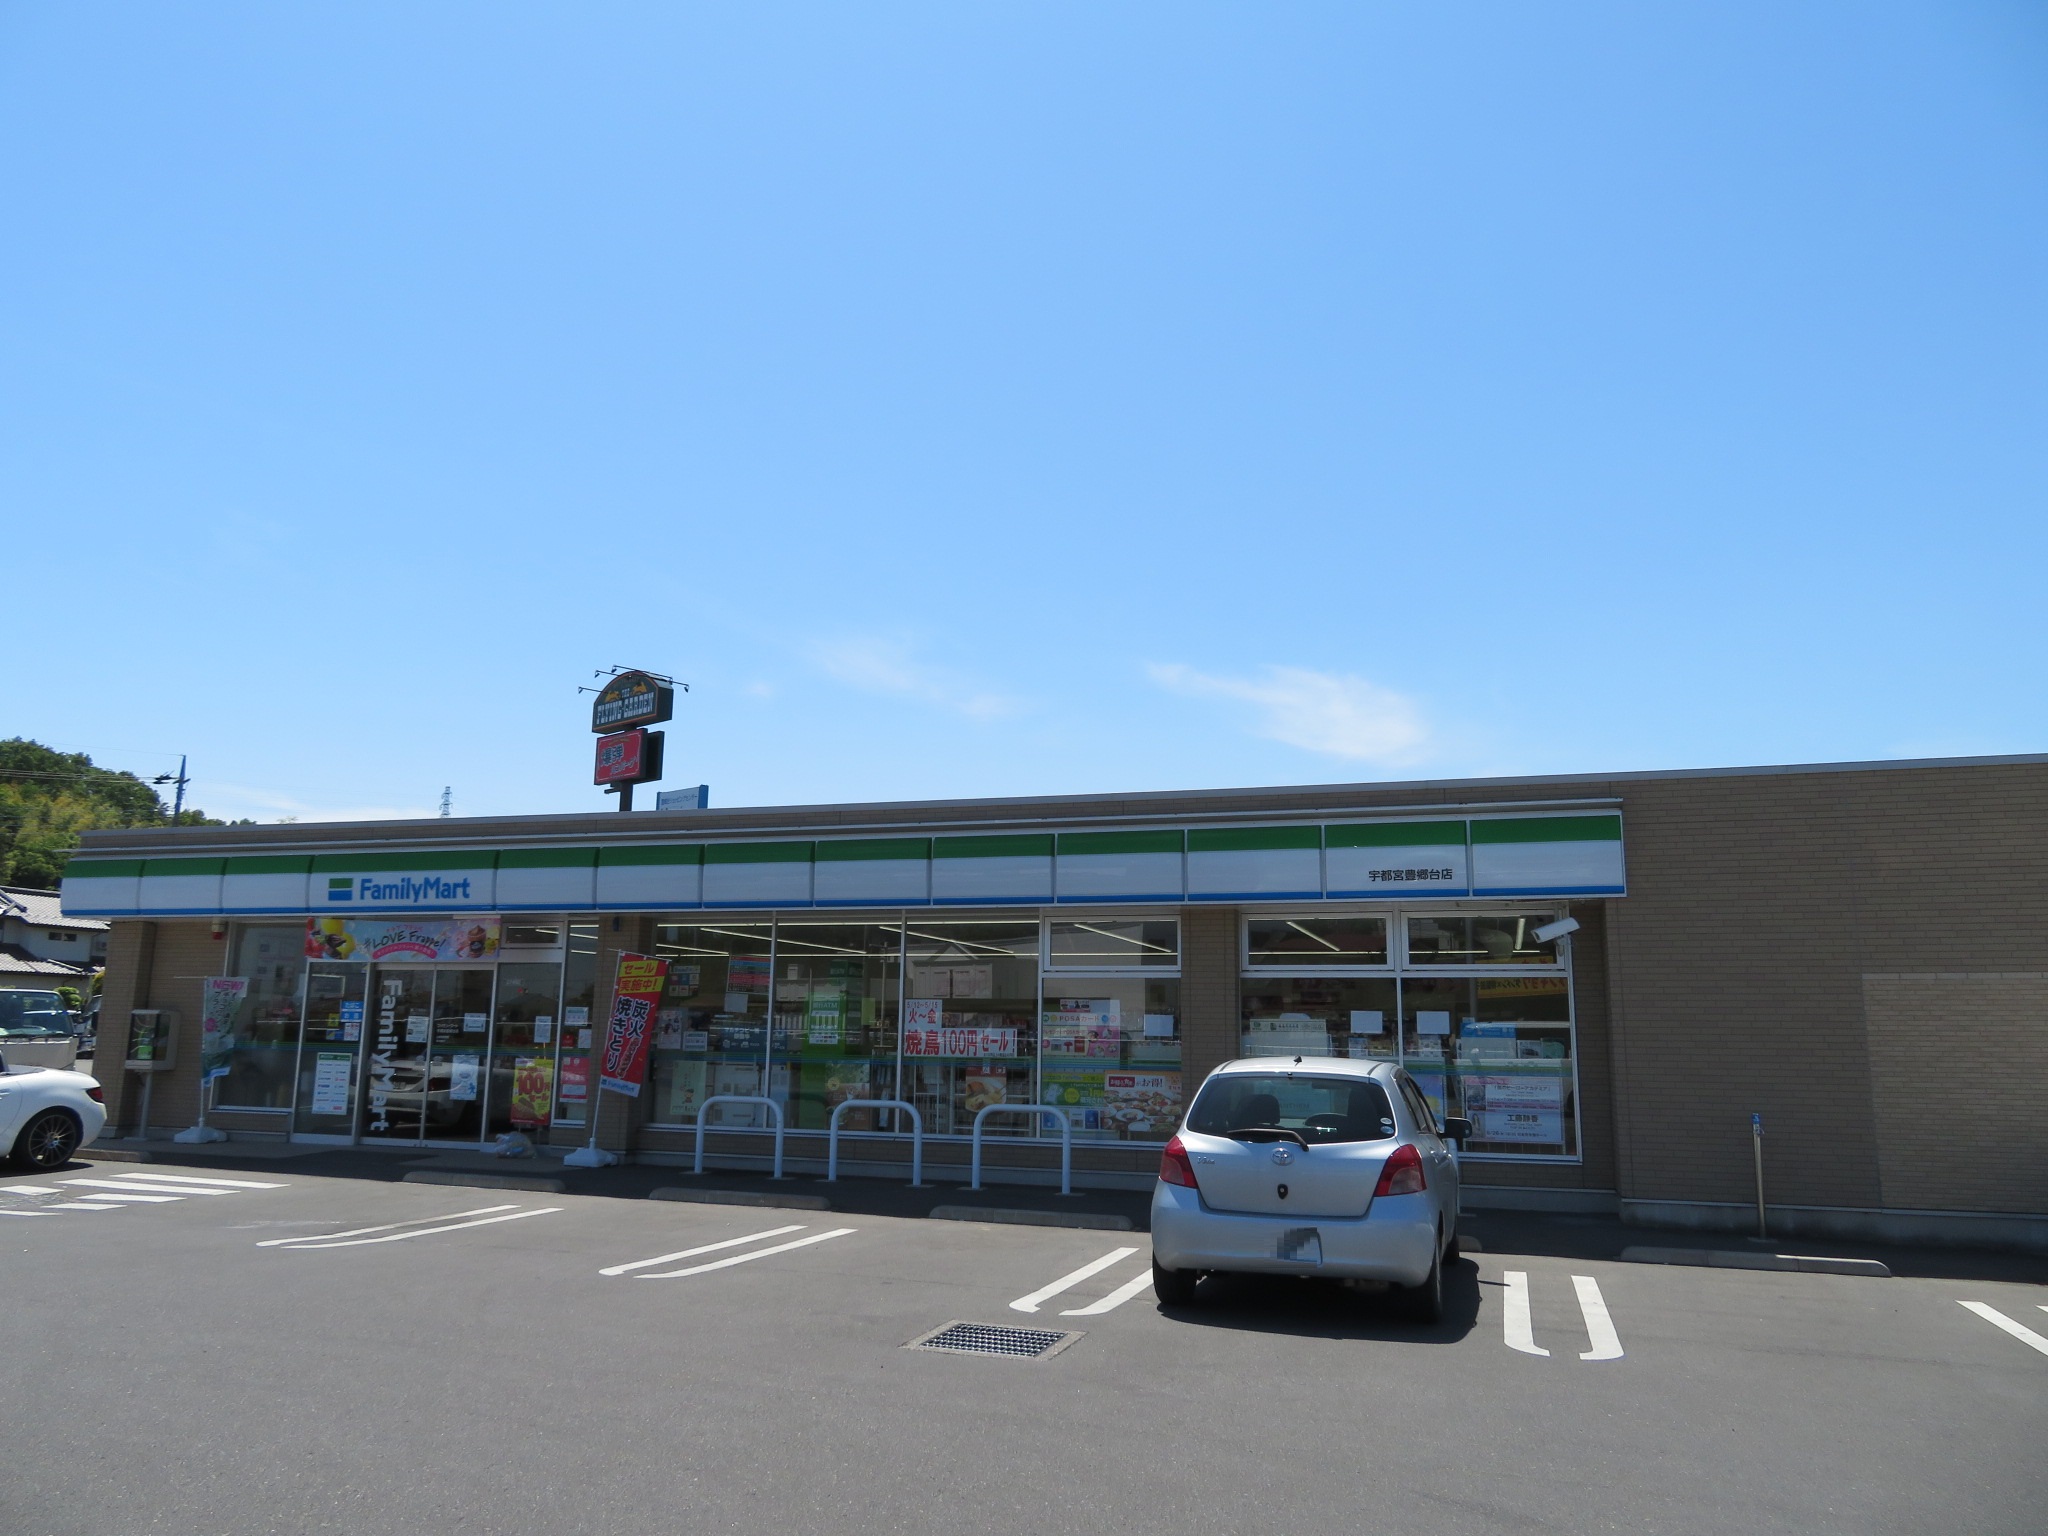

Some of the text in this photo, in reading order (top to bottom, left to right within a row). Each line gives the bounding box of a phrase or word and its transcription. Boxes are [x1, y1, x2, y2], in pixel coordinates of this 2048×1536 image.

[596, 691, 654, 725] FLYING GARDEN
[1368, 867, 1453, 882] 宇都宮豊郷台店
[360, 876, 471, 903] FamilyMart
[624, 963, 655, 975] セール
[619, 978, 658, 992] 実施中!
[627, 998, 650, 1039] 炭火
[607, 995, 632, 1072] 焼きとり
[905, 1029, 978, 1056] 焼鳥100円
[368, 979, 404, 1132] FamilyMart
